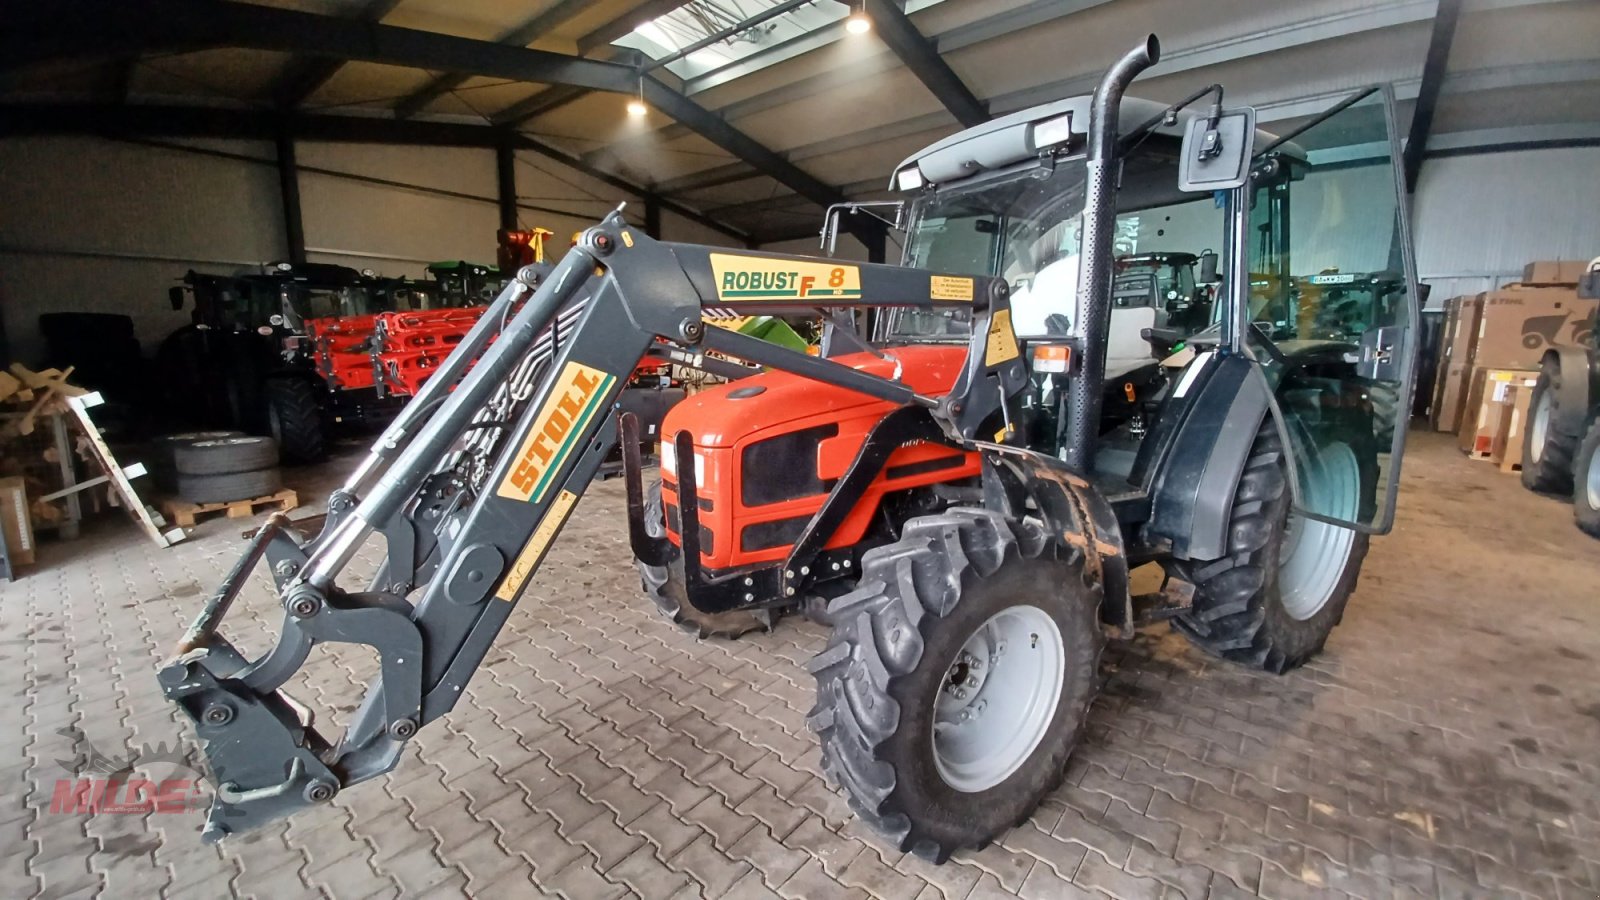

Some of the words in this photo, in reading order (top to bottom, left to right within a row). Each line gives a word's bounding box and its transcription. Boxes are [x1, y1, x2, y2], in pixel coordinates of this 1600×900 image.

[722, 272, 798, 289] ROBUST
[800, 276, 815, 297] F
[828, 268, 845, 287] 8
[510, 369, 600, 495] STOLL
